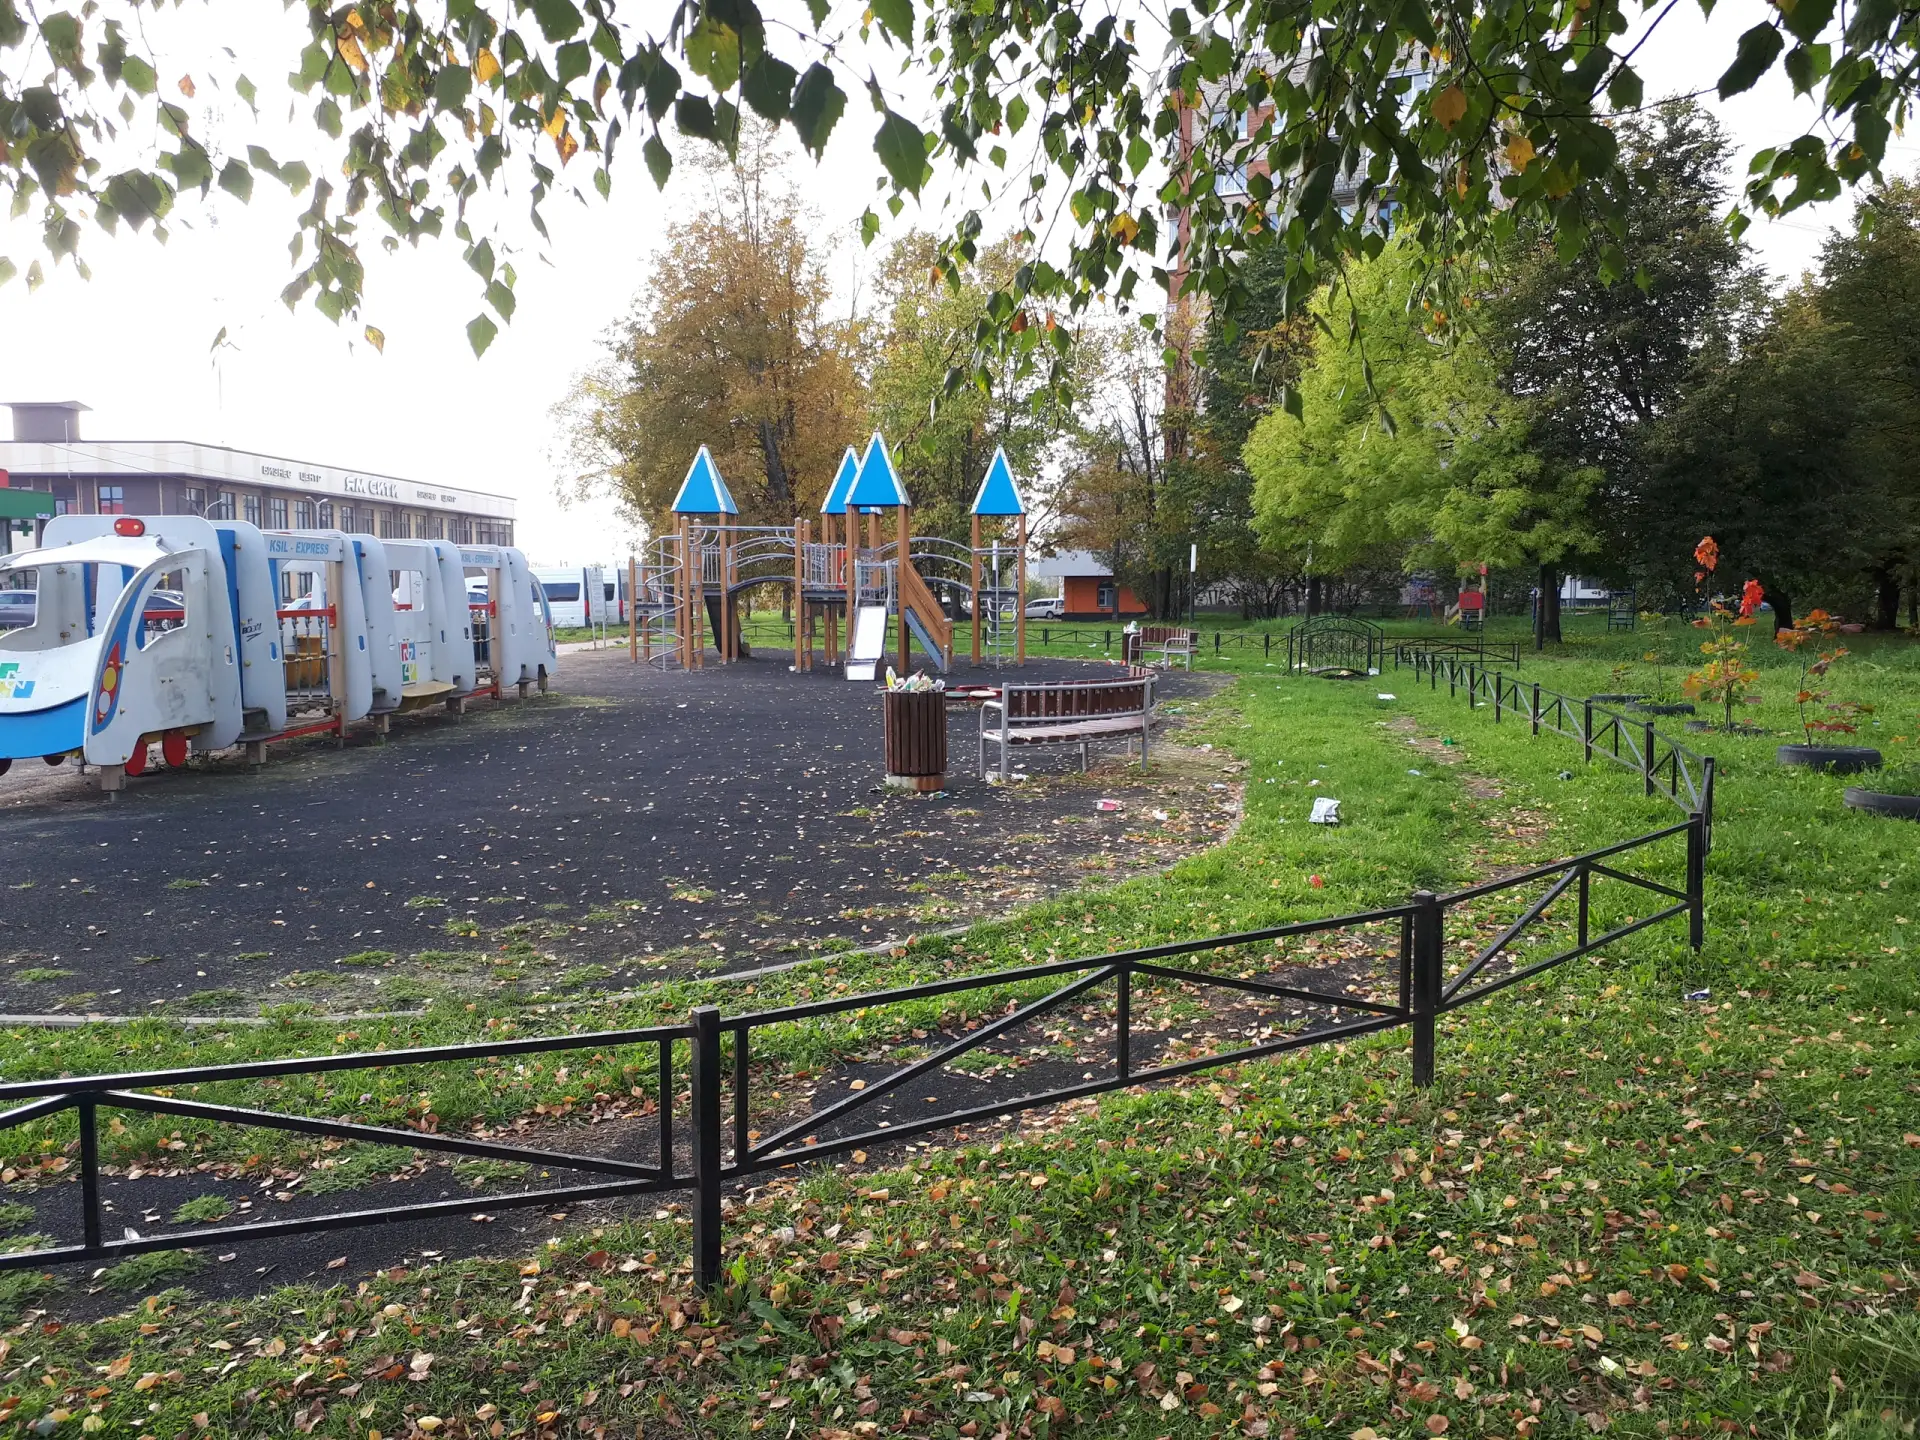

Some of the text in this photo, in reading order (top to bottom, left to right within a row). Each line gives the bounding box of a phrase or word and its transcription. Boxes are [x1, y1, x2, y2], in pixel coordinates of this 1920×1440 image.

[262, 465, 322, 483] БИЗНЕС ЦЕНТР
[344, 477, 398, 499] ЯМ СИТИ
[269, 540, 289, 552] KSIL
[296, 542, 329, 555] EXPRESS
[461, 554, 471, 563] KSIL
[475, 554, 493, 564] EXPRESS
